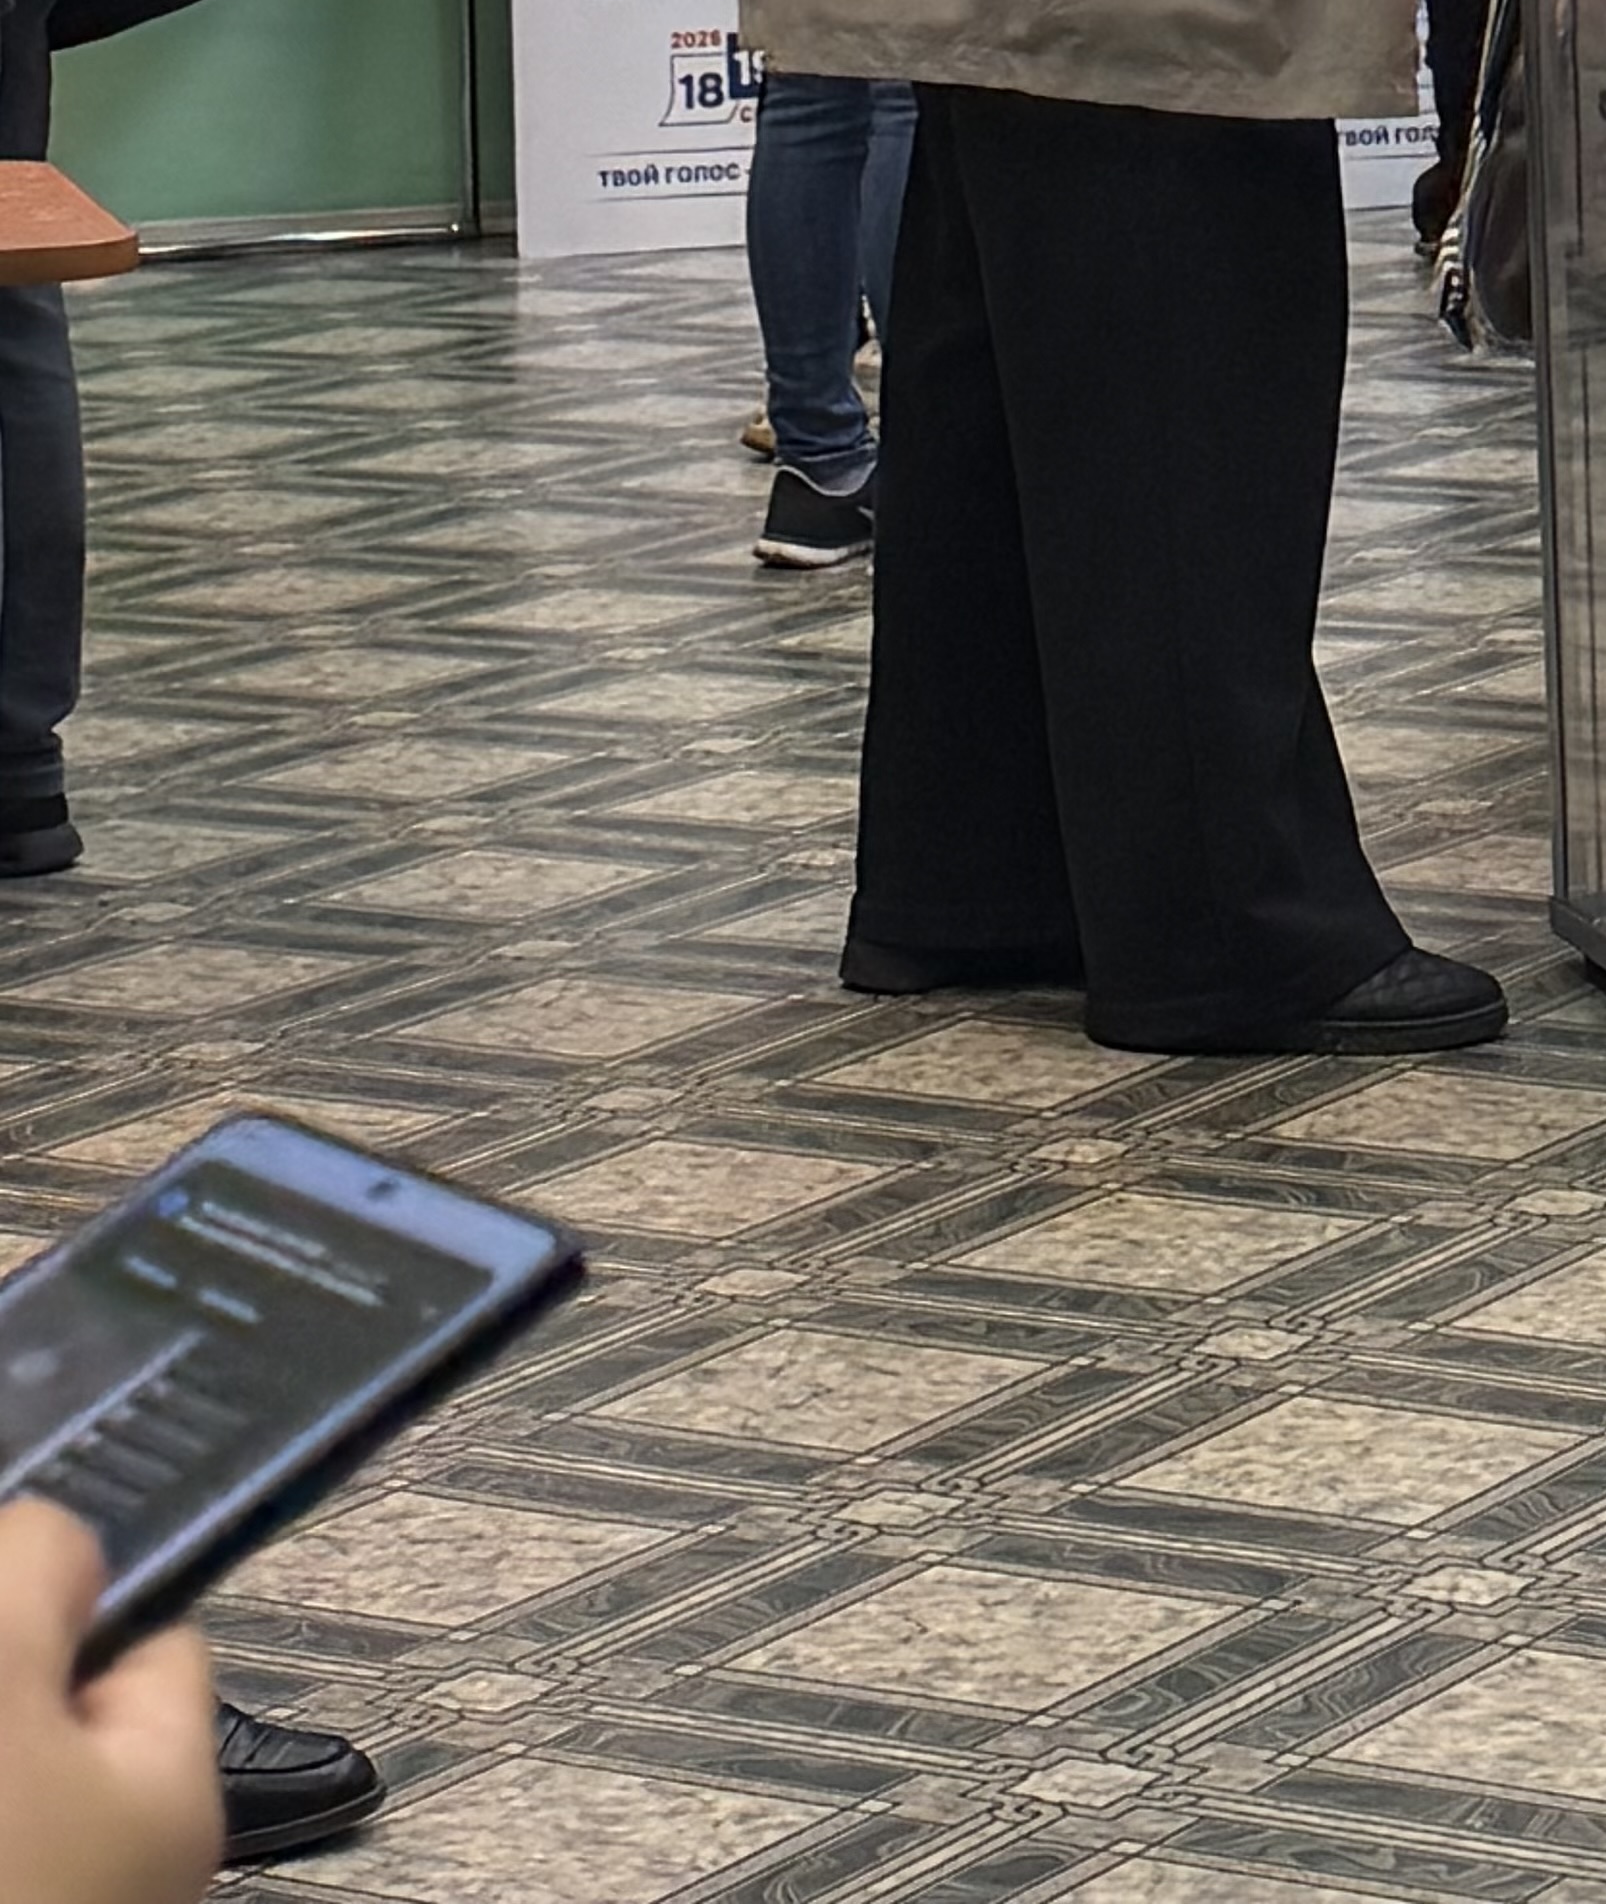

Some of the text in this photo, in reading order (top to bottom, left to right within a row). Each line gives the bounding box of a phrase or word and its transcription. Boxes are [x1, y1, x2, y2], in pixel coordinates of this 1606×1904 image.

[671, 29, 721, 49] 2026
[678, 72, 725, 109] 18
[1339, 125, 1389, 146] ВОЙ
[598, 163, 741, 188] ТВОЙ ГОЛОС
